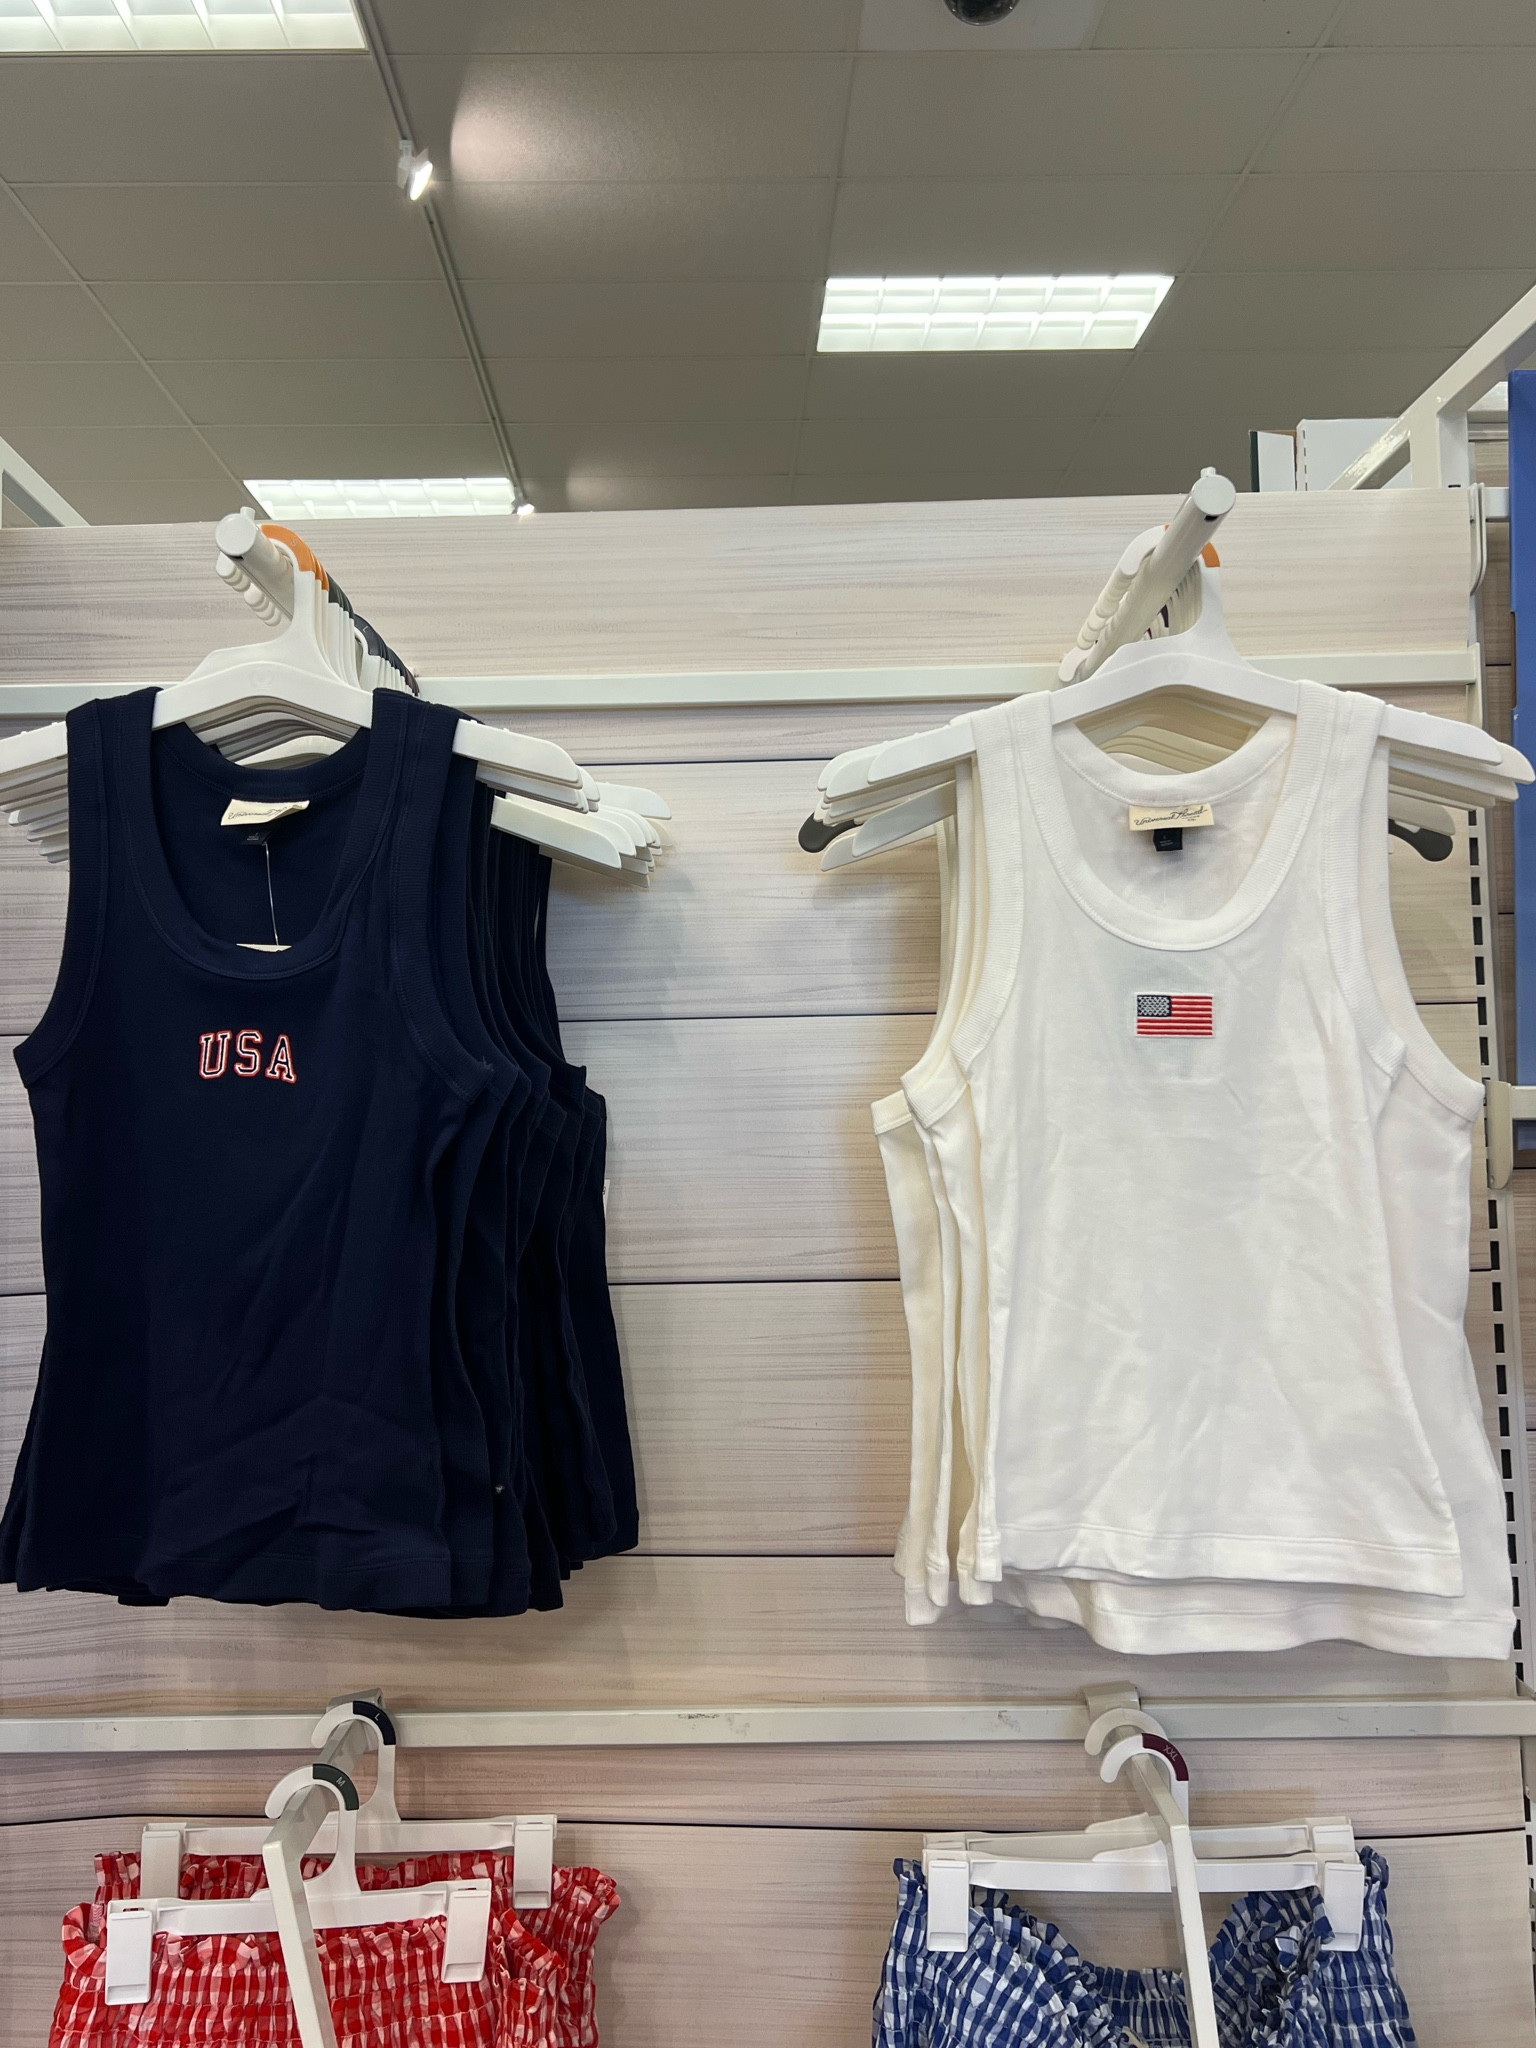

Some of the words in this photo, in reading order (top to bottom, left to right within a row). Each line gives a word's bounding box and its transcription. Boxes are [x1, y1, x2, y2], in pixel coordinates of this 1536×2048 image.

[199, 1029, 298, 1084] USA
[374, 1712, 381, 1721] L
[1163, 1744, 1178, 1762] XXL
[336, 1776, 346, 1787] M
